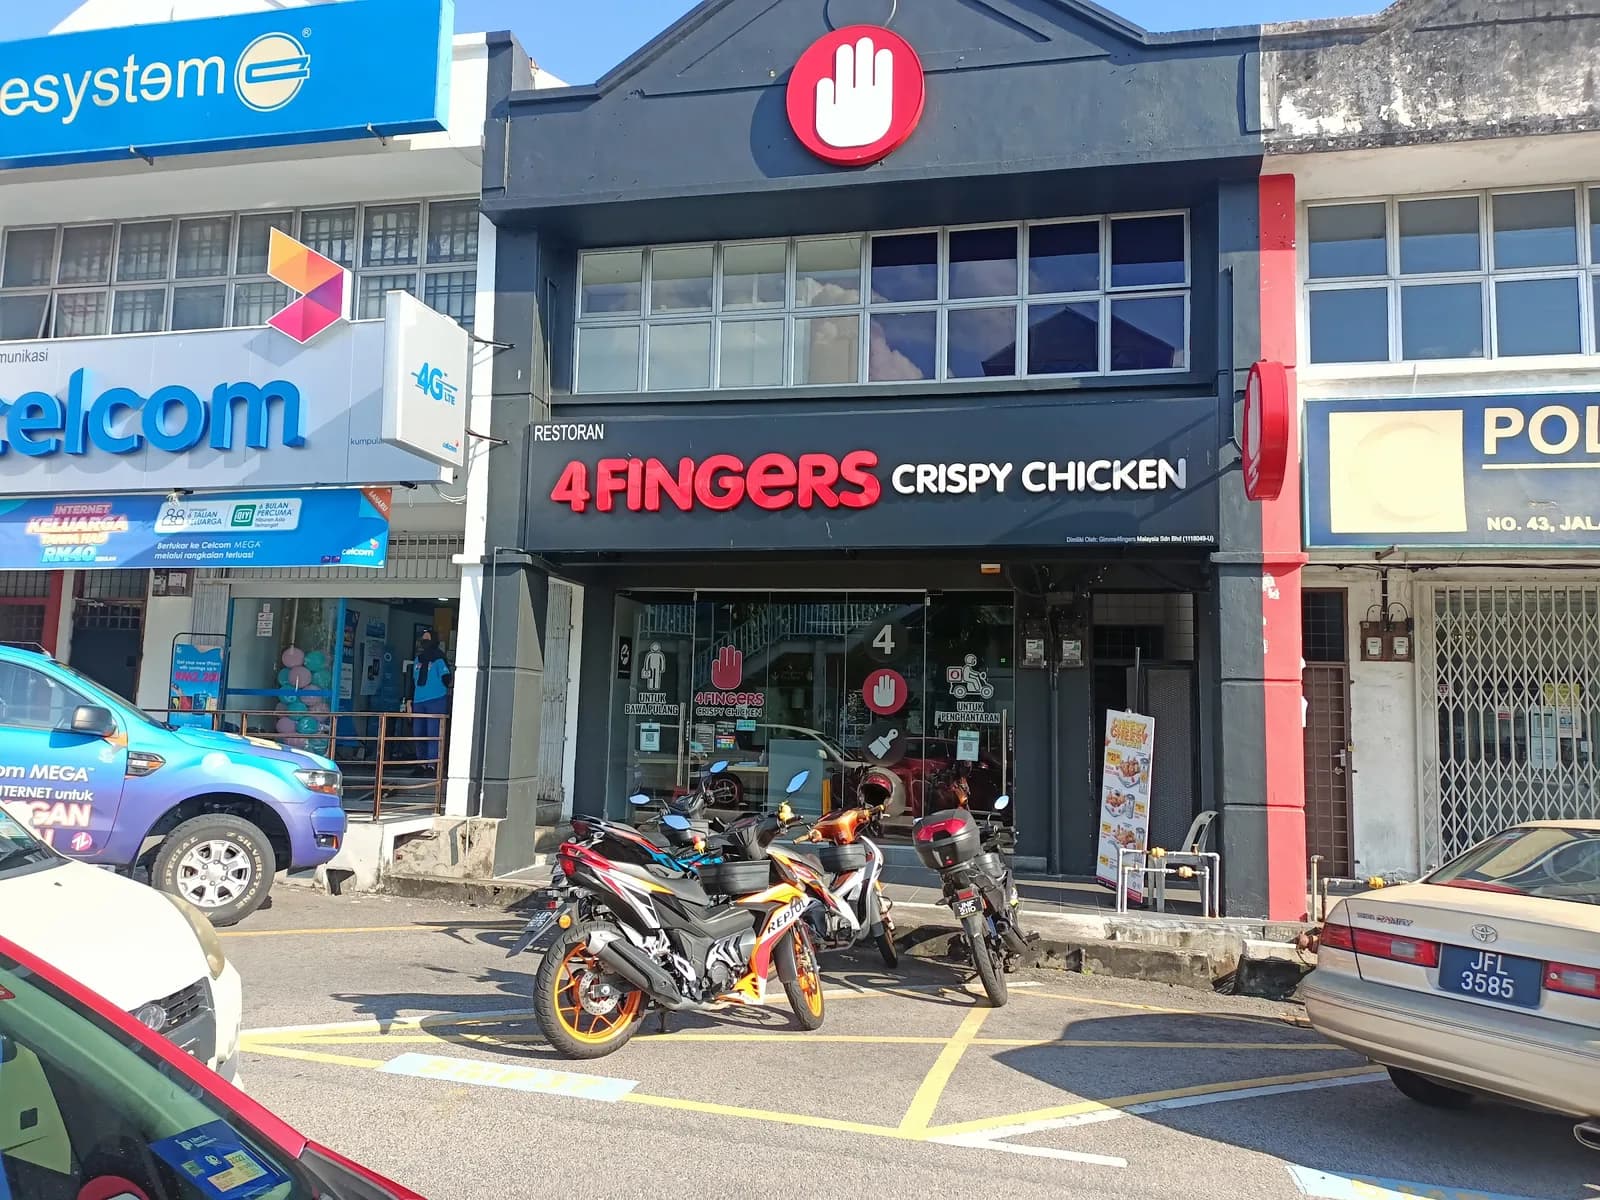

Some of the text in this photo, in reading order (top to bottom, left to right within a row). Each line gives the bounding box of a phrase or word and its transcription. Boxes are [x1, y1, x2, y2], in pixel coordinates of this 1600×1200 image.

[444, 392, 456, 406] LTE
[534, 423, 604, 442] RESTORAN
[891, 461, 1012, 495] CRISPY
[1021, 457, 1187, 493] CHICKEN
[55, 503, 111, 514] INTERNET
[256, 509, 292, 517] PERCUMA
[1487, 516, 1600, 533] NO. 43, JAL
[157, 542, 188, 550] Bertukar
[201, 541, 231, 549] Celcom
[234, 541, 261, 549] MEGA
[41, 545, 96, 562] RM40
[154, 552, 183, 560] melalui
[184, 551, 224, 561] rangkaian
[872, 624, 896, 654] 4
[639, 692, 667, 704] UNTUK
[624, 703, 679, 716] BAWA PULANG
[696, 706, 762, 718] CRISPY CHICKEN
[956, 701, 984, 713] UNTUK
[940, 711, 1001, 724] PENGHANTARAN
[30, 764, 89, 782] MEGA
[55, 789, 94, 801] untuk
[1470, 951, 1509, 976] JFL
[1461, 971, 1514, 999] 3585
